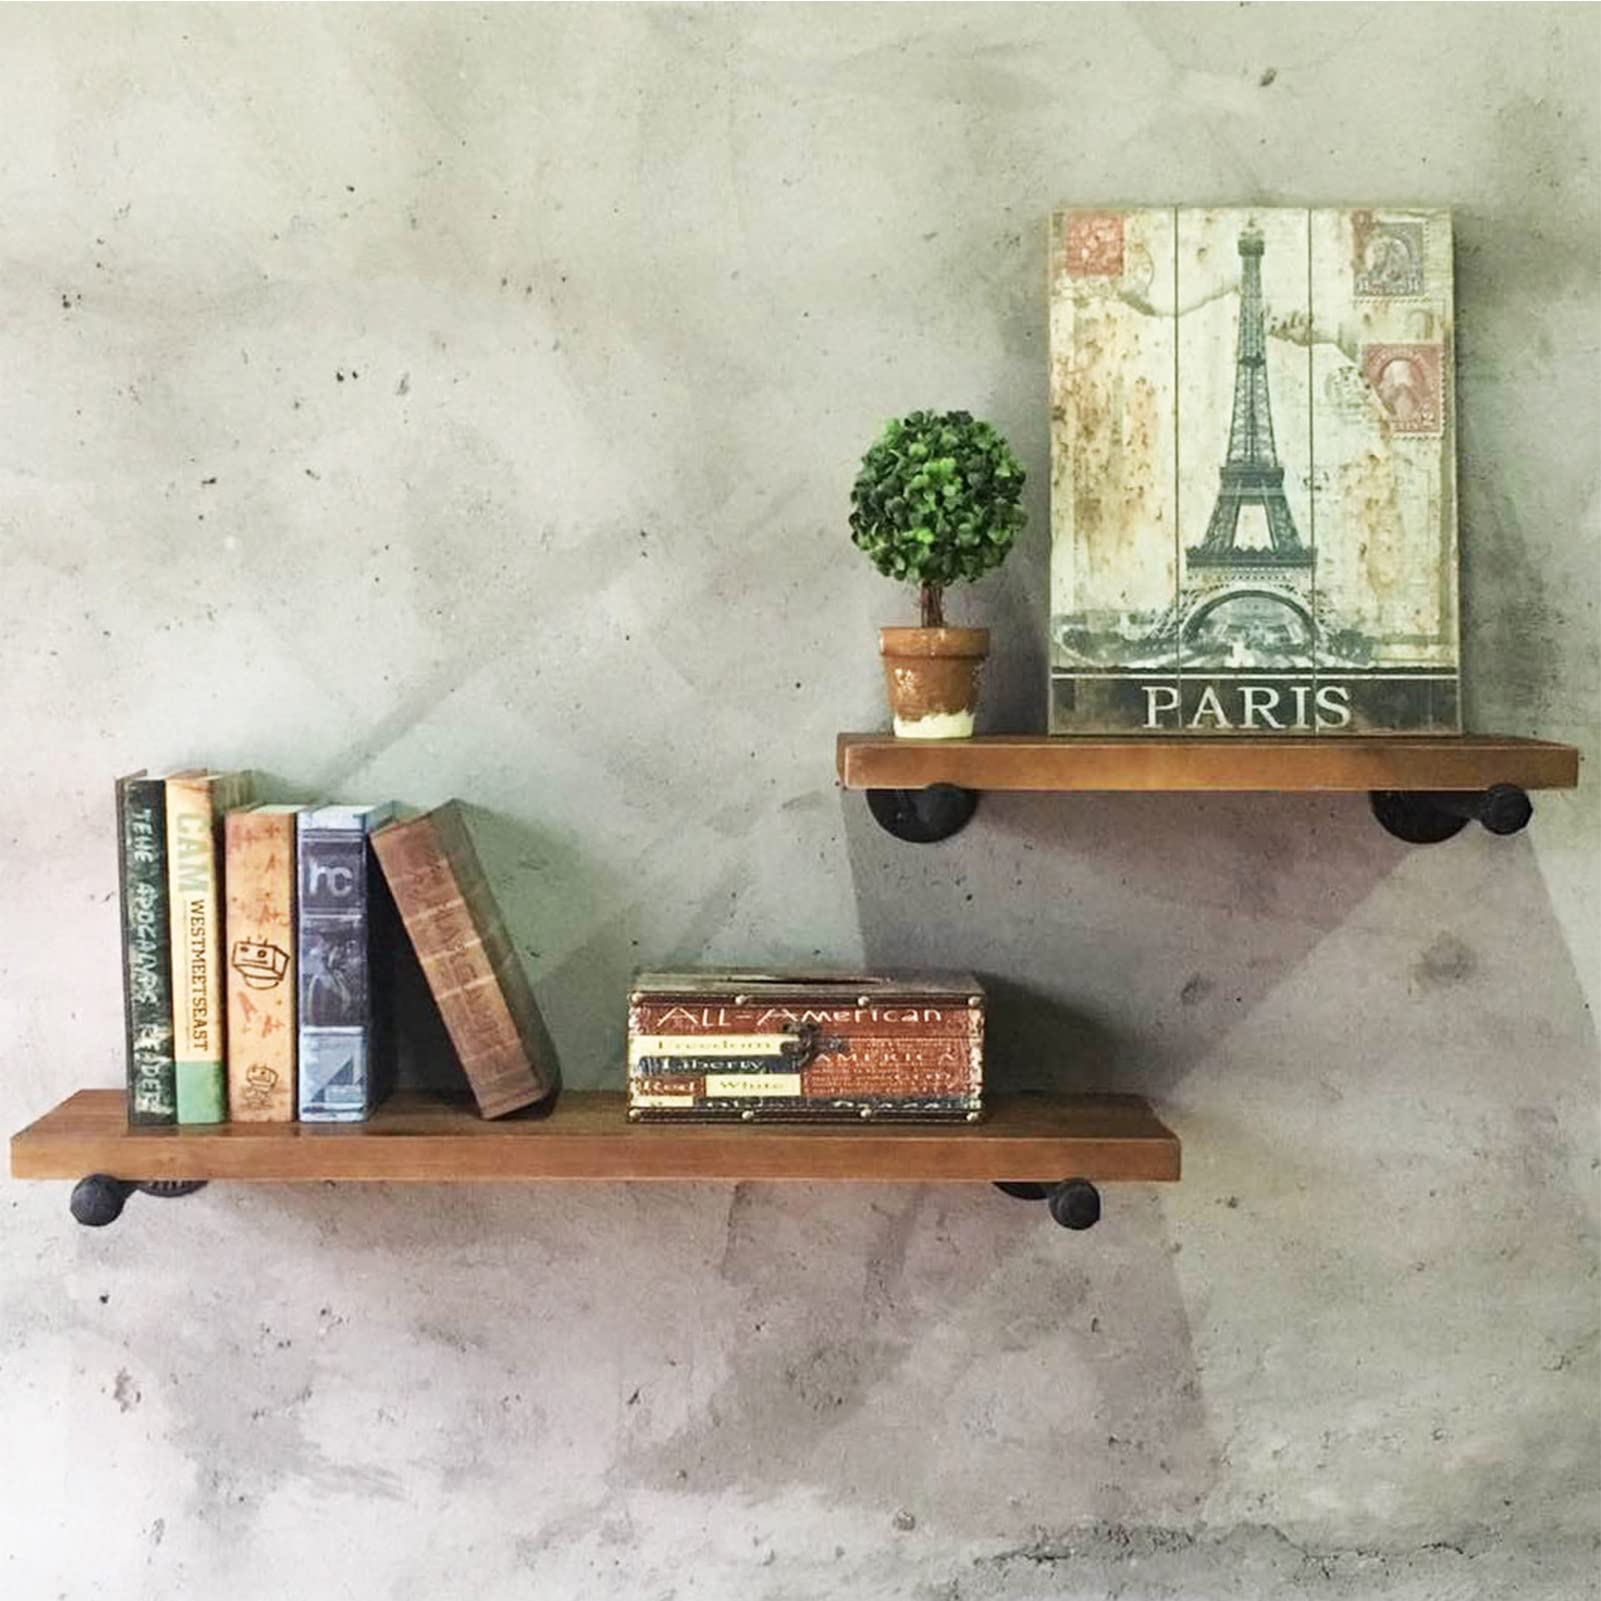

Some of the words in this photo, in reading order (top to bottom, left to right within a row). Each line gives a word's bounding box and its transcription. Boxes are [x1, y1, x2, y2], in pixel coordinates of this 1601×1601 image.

[1141, 685, 1351, 729] PARIS
[177, 812, 209, 893] CAM
[190, 899, 208, 1052] WESTMEETSEAST
[661, 1058, 766, 1073] Liberty
